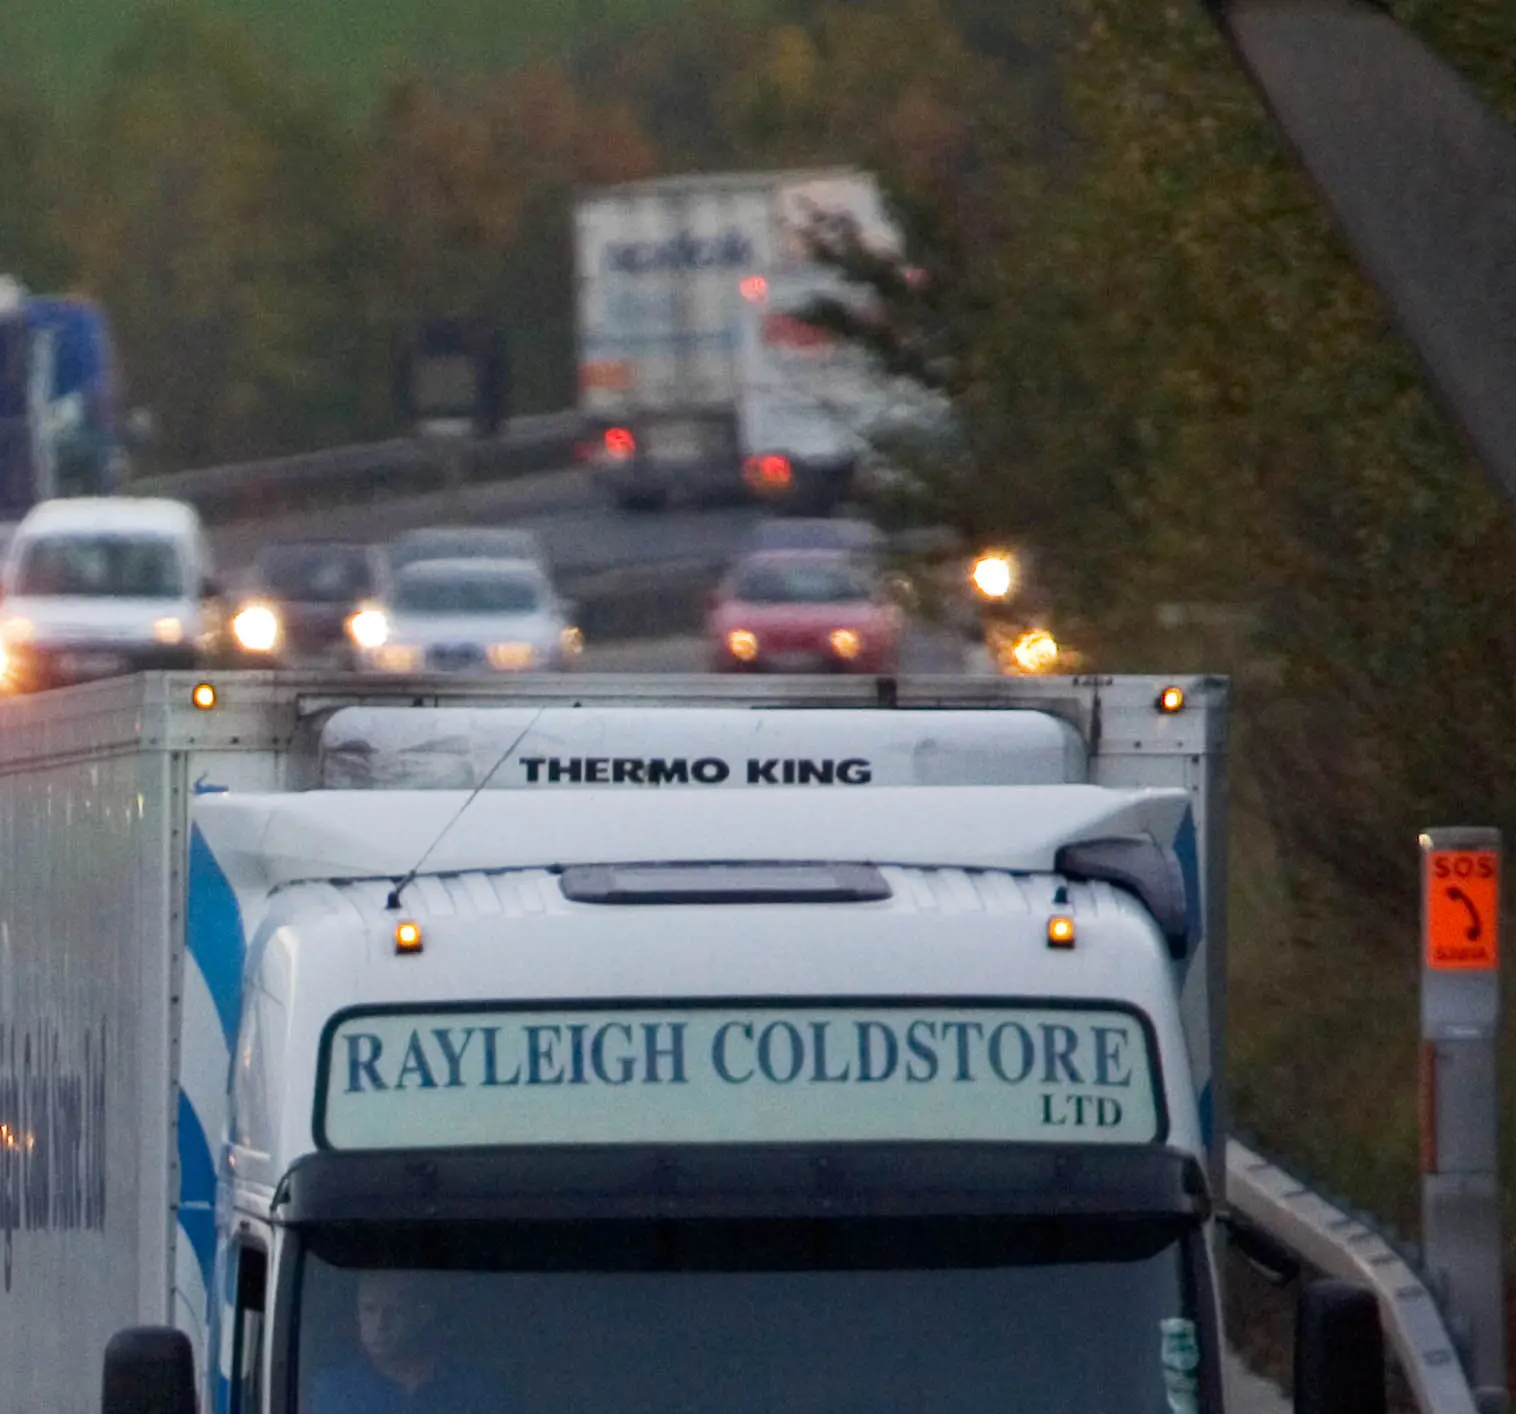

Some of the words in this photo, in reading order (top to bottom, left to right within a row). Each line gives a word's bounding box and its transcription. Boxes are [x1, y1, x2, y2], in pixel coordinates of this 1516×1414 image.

[518, 756, 731, 785] THERMO
[746, 757, 873, 785] KING
[1434, 856, 1494, 878] SOS
[343, 1021, 690, 1093] RAYLEIGH
[710, 1019, 1133, 1088] COLDSTORE
[1040, 1093, 1124, 1128] LTD
